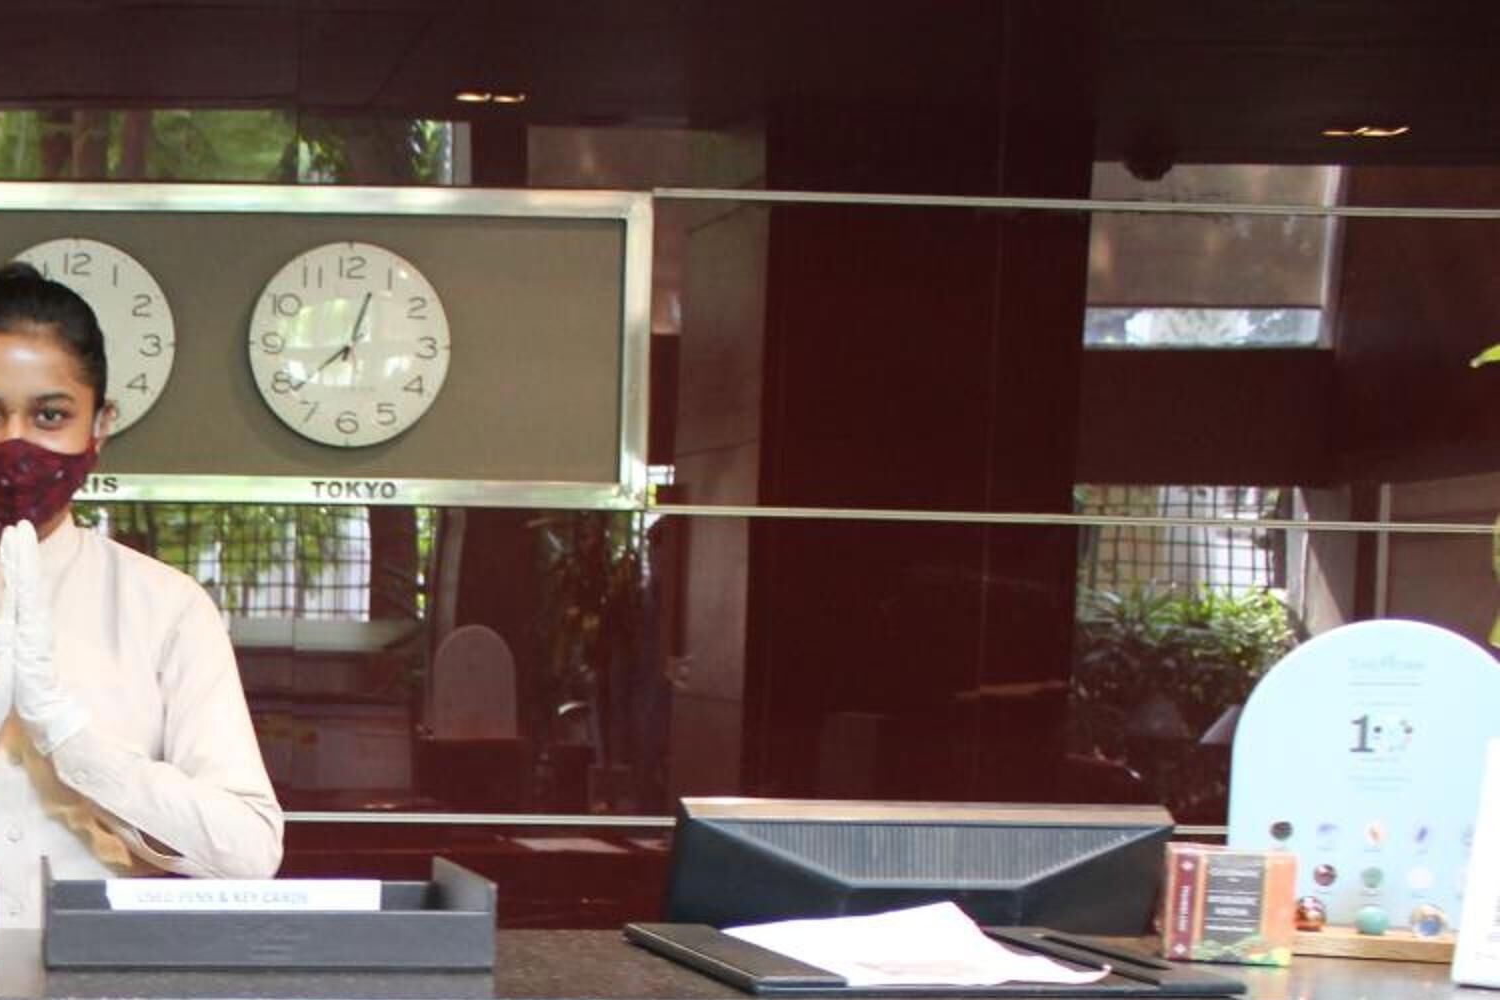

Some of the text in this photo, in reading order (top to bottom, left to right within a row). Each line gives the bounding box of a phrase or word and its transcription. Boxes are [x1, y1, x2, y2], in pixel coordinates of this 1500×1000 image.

[63, 252, 92, 276] 12
[112, 264, 118, 287] 1
[339, 255, 368, 280] 12
[302, 264, 323, 289] 11
[387, 266, 394, 291] 1
[131, 293, 153, 318] 2
[271, 292, 302, 317] 10
[406, 296, 428, 320] 2
[138, 333, 162, 357] 3
[261, 331, 285, 355] 9
[416, 335, 438, 360] 3
[125, 372, 149, 395] 4
[270, 370, 294, 395] 8
[403, 375, 425, 396] 4
[299, 401, 320, 424] 7
[334, 410, 360, 435] 6
[375, 402, 398, 426] 5
[310, 480, 398, 499] TOKYO
